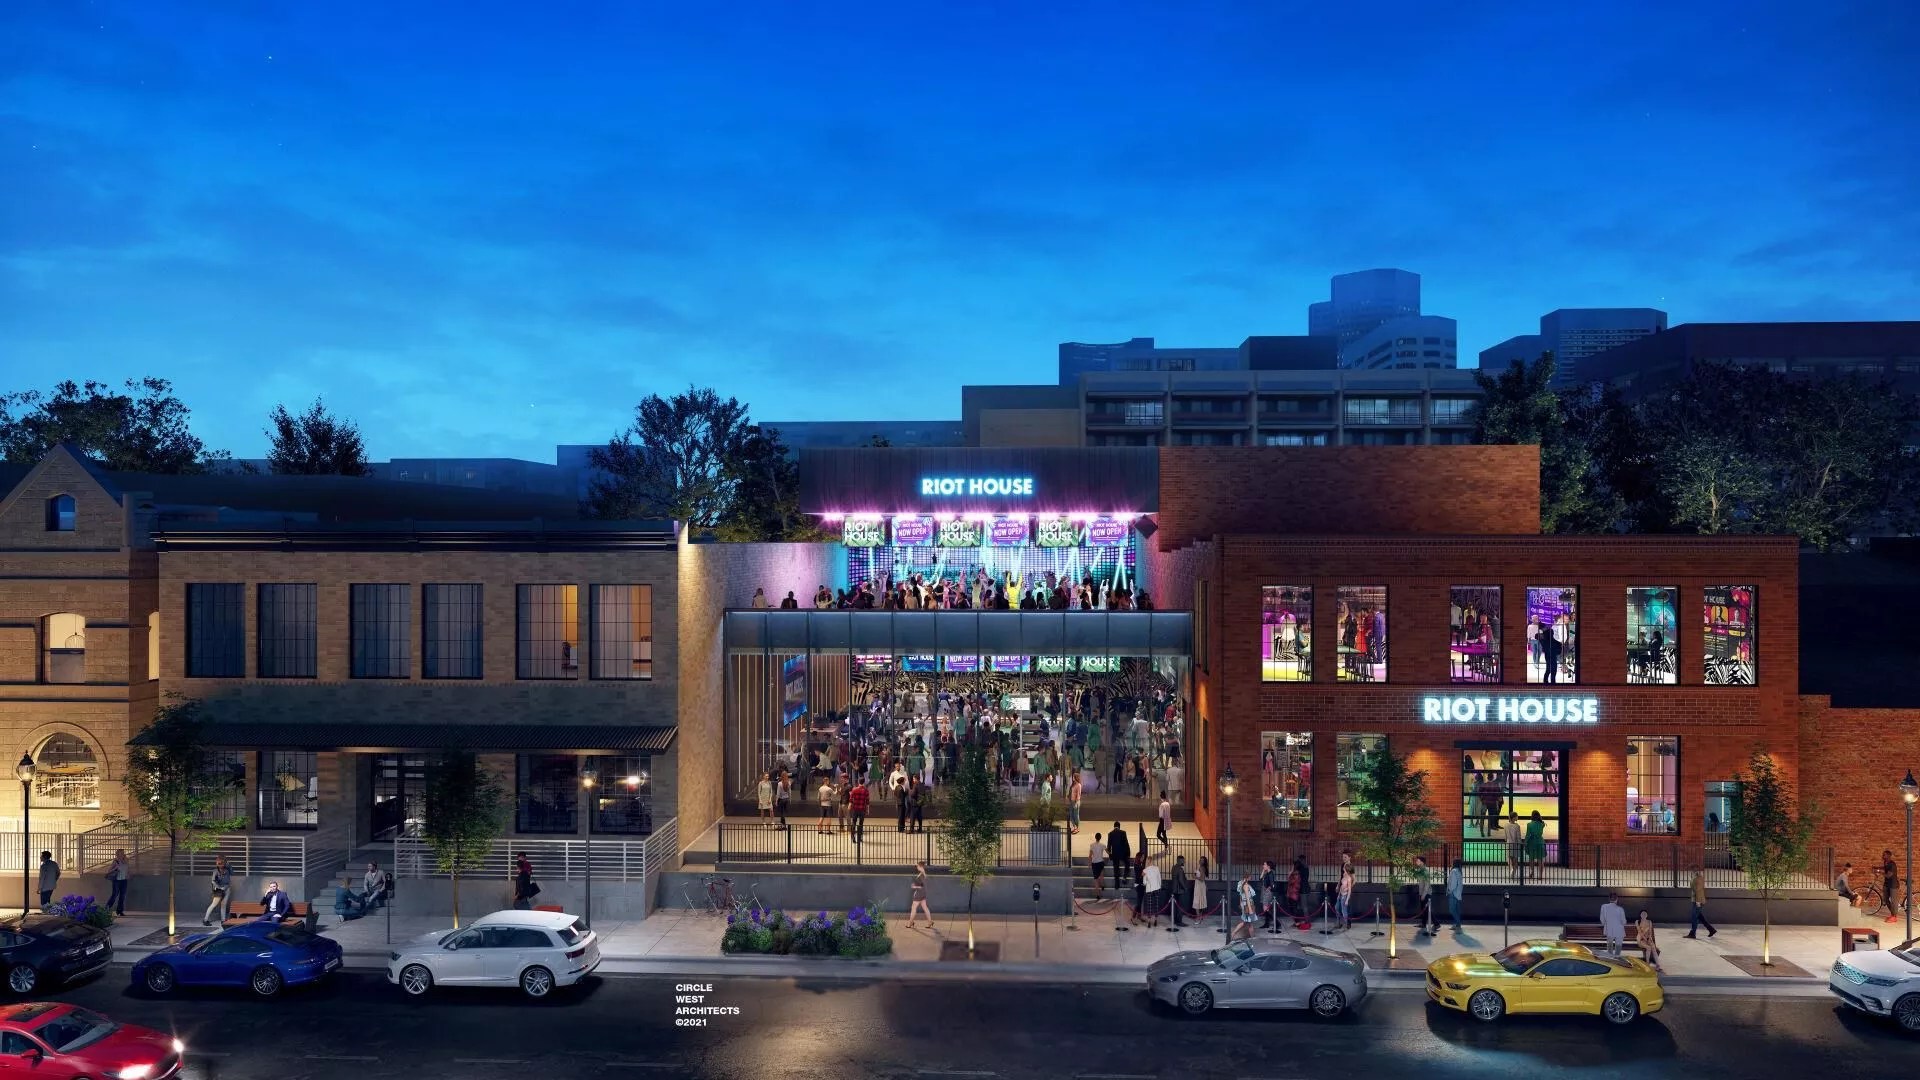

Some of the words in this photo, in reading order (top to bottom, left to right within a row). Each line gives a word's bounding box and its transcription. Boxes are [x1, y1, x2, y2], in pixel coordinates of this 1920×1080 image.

[922, 478, 965, 495] RIOT
[969, 478, 1033, 495] HOUSE
[844, 520, 871, 532] RIOT
[940, 520, 965, 532] RIOT
[1039, 520, 1063, 532] RIOT
[844, 531, 880, 541] HOUSE
[898, 529, 911, 537] NOW
[912, 527, 927, 536] OPEN
[940, 531, 975, 541] HOUSE
[994, 529, 1006, 537] NOW
[1007, 527, 1023, 536] OPEN
[1039, 531, 1073, 541] HOUSE
[1092, 529, 1105, 537] NOW
[1106, 527, 1122, 536] OPEN
[1039, 656, 1071, 667] HOUSE
[1424, 697, 1491, 722] RIOT
[1498, 698, 1598, 723] HOUSE
